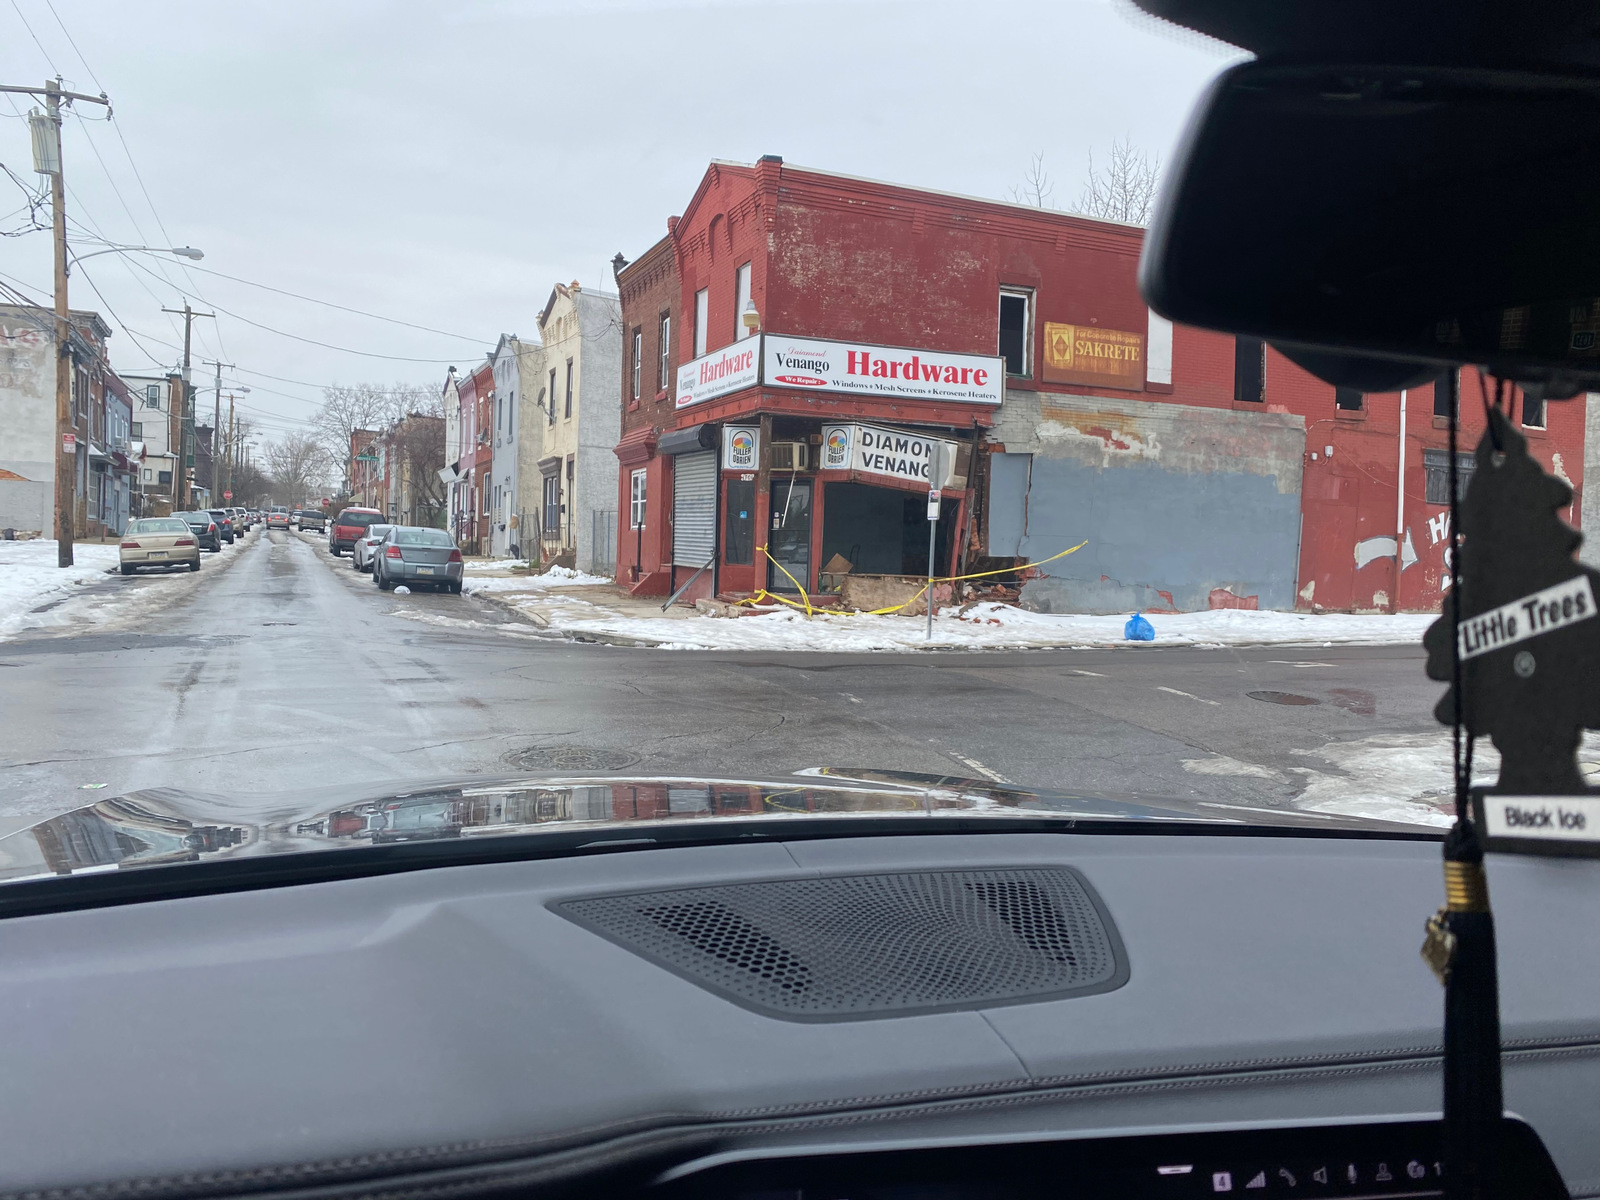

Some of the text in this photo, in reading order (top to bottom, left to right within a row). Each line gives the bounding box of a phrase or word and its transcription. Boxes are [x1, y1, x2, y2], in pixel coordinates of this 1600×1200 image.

[1076, 330, 1086, 338] For
[1087, 330, 1116, 341] Concrete
[1075, 340, 1140, 361] SAKRETE
[699, 350, 753, 385] Hardware
[775, 352, 830, 375] Venango
[846, 350, 988, 386] Hardware
[832, 379, 997, 400] Windows Mesh Screens Kerosene Heaters
[733, 446, 751, 456] FULLER
[829, 444, 845, 455] FULLER
[861, 431, 932, 458] DIAMON
[861, 451, 929, 478] VENANG
[1462, 591, 1587, 653] Little Trees
[1505, 805, 1587, 829] Black Ice
